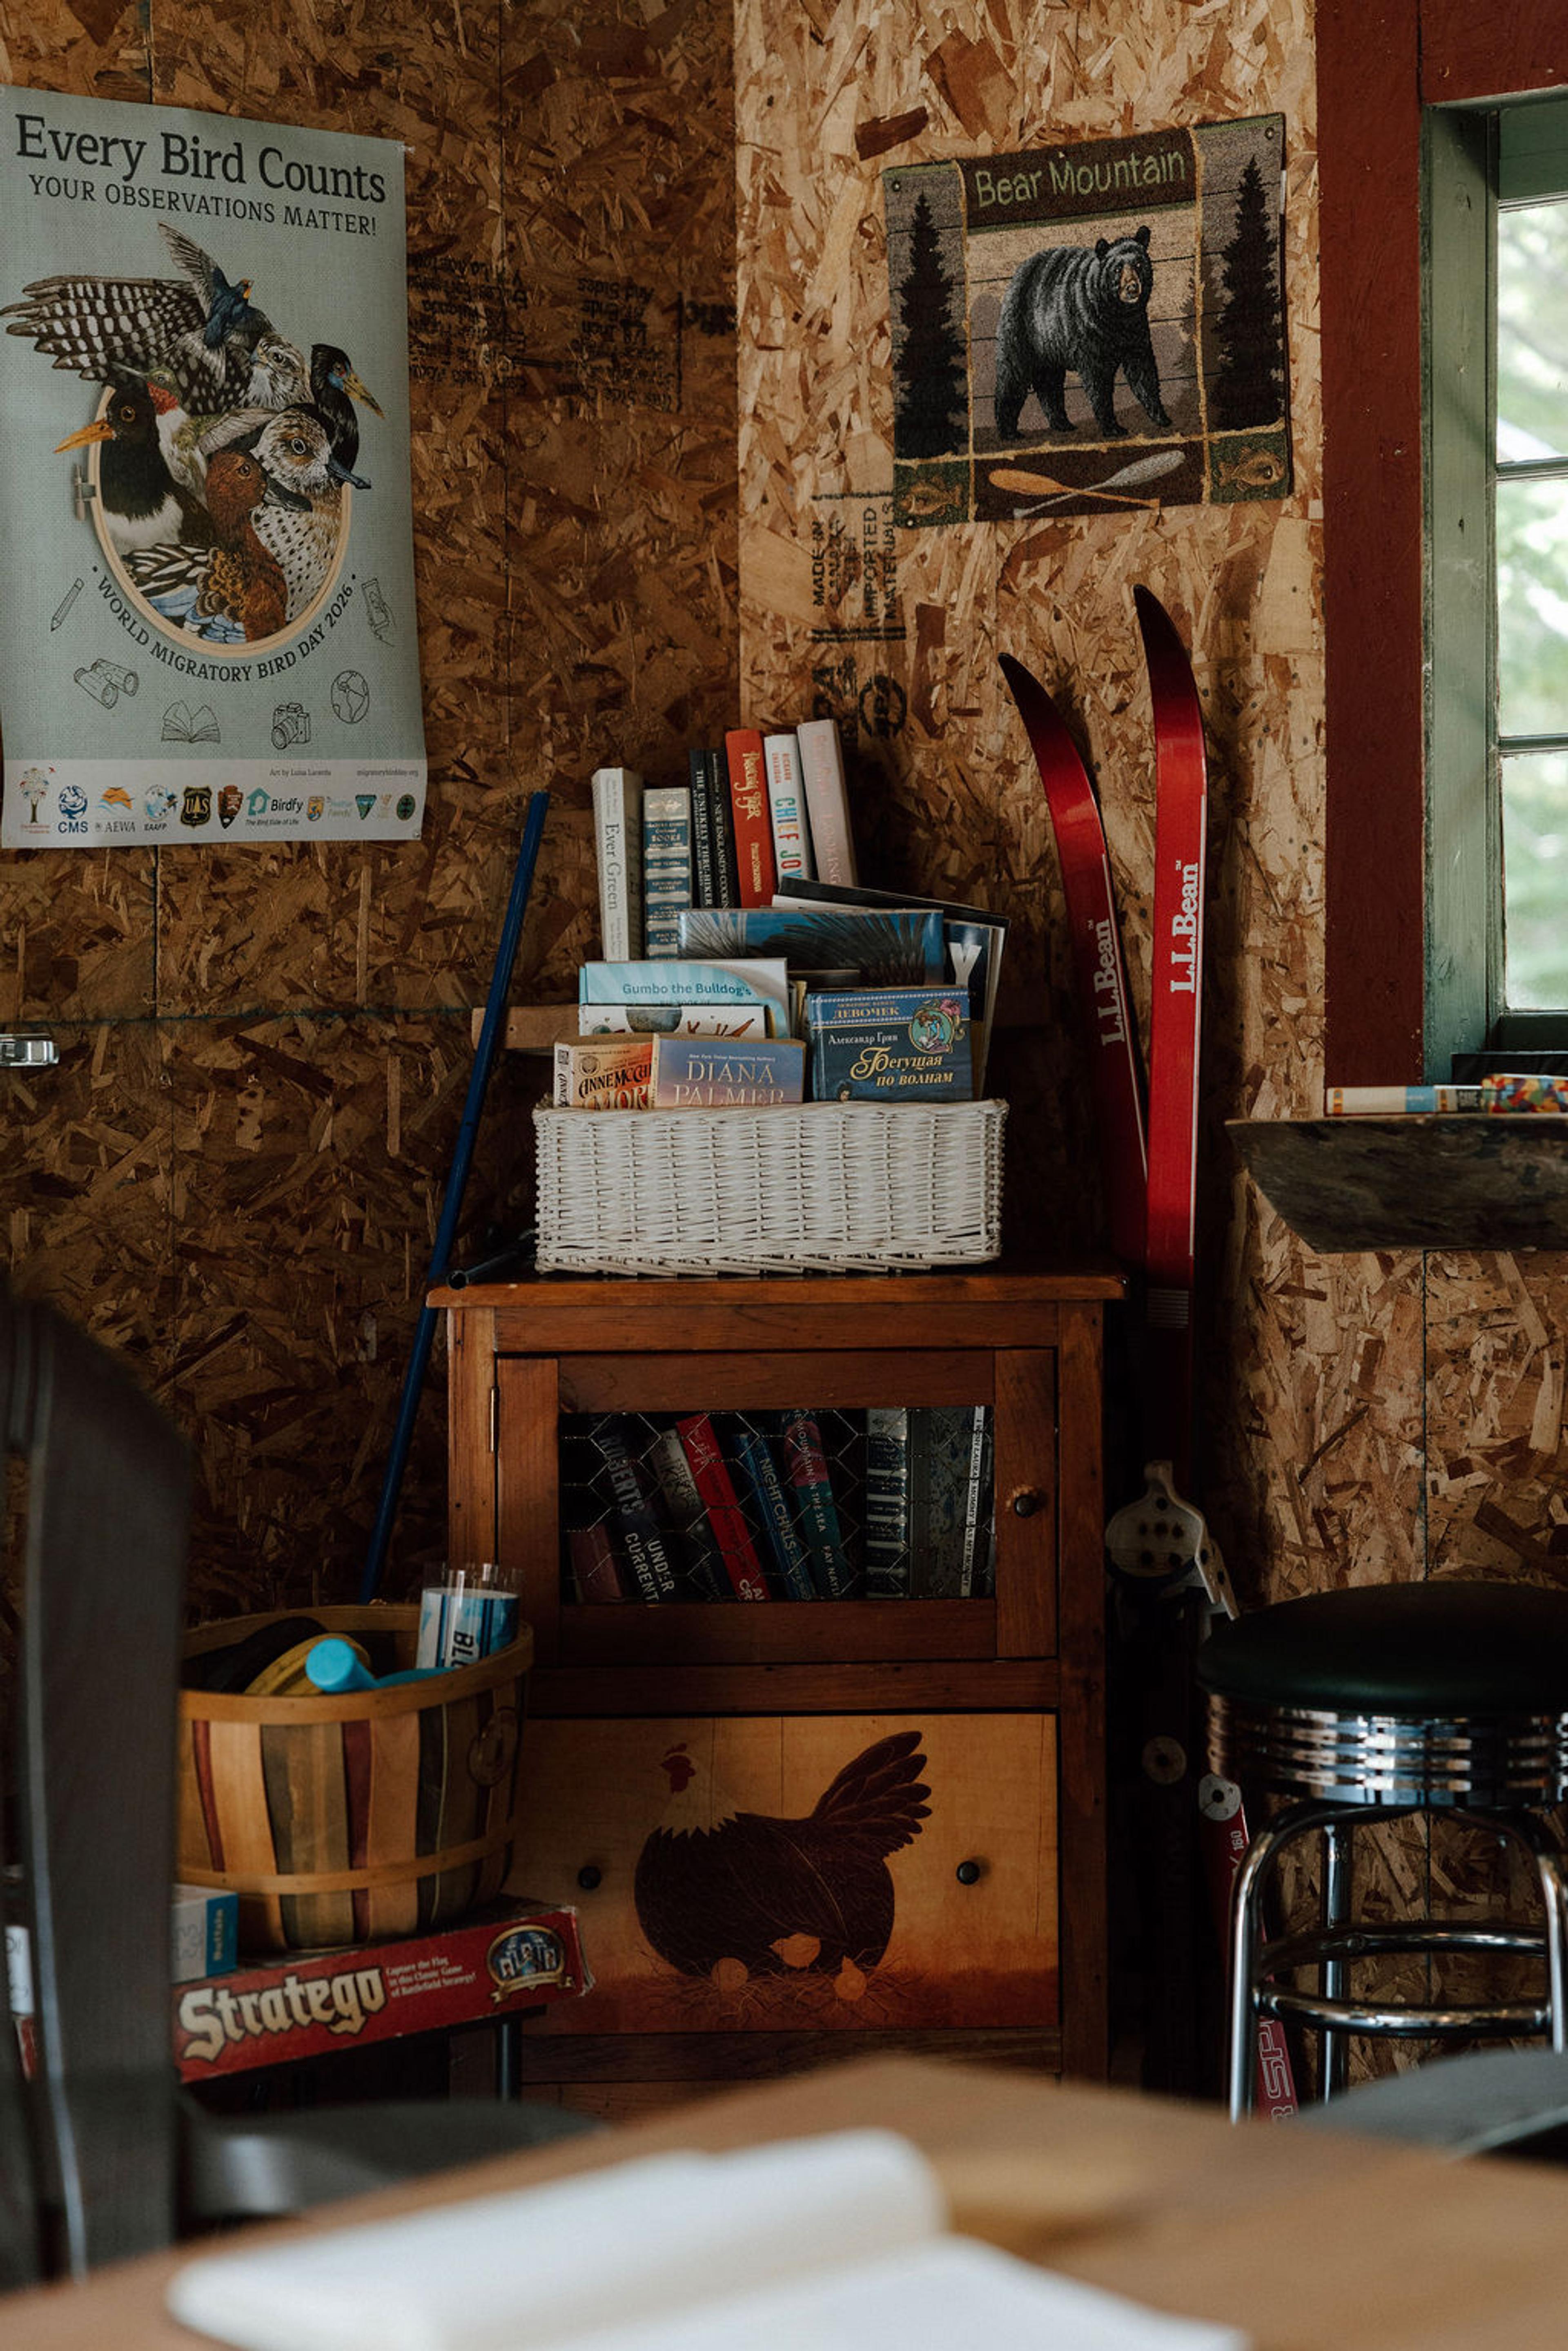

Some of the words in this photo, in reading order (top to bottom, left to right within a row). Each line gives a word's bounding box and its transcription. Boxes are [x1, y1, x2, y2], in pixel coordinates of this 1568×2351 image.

[16, 114, 146, 181] Every
[160, 132, 245, 185] Bird
[258, 147, 387, 203] Counts
[976, 171, 1042, 207] Bear
[1049, 149, 1184, 196] Mountain
[29, 174, 96, 202] YOUR
[105, 183, 275, 223] OBSERVATIONS
[283, 206, 376, 236] MATTER!
[812, 550, 824, 607] MADE
[863, 507, 877, 618] IMPORTED
[881, 502, 896, 619] MATERIALS
[98, 575, 149, 645] WORLD
[150, 642, 253, 682] MIGRATORY
[257, 651, 297, 680] BIRD
[298, 628, 326, 659] DAY
[327, 585, 354, 628] 2026
[58, 821, 88, 834] CMS
[105, 821, 136, 833] AEWA
[271, 799, 303, 814] Birdfy
[775, 798, 799, 841] CHIEF
[605, 823, 619, 857] Ever
[605, 863, 621, 909] Green
[1170, 863, 1198, 993] L.L.Bean
[623, 984, 668, 995] Gumbo
[672, 983, 692, 994] the
[696, 983, 751, 997] Bulldog's
[1093, 919, 1125, 1046] L.L.Bean
[833, 1006, 899, 1019] ДЕВОЧЕК
[829, 1034, 875, 1046] Александр
[850, 1046, 942, 1080] Бегущая
[686, 1061, 774, 1084] DIANA
[876, 1076, 894, 1086] по
[899, 1071, 953, 1085] волнам
[760, 1457, 783, 1501] NIGHT
[774, 1503, 797, 1551] CHILLS
[647, 1539, 675, 1593] UNDER
[178, 1966, 387, 2062] Stratego
